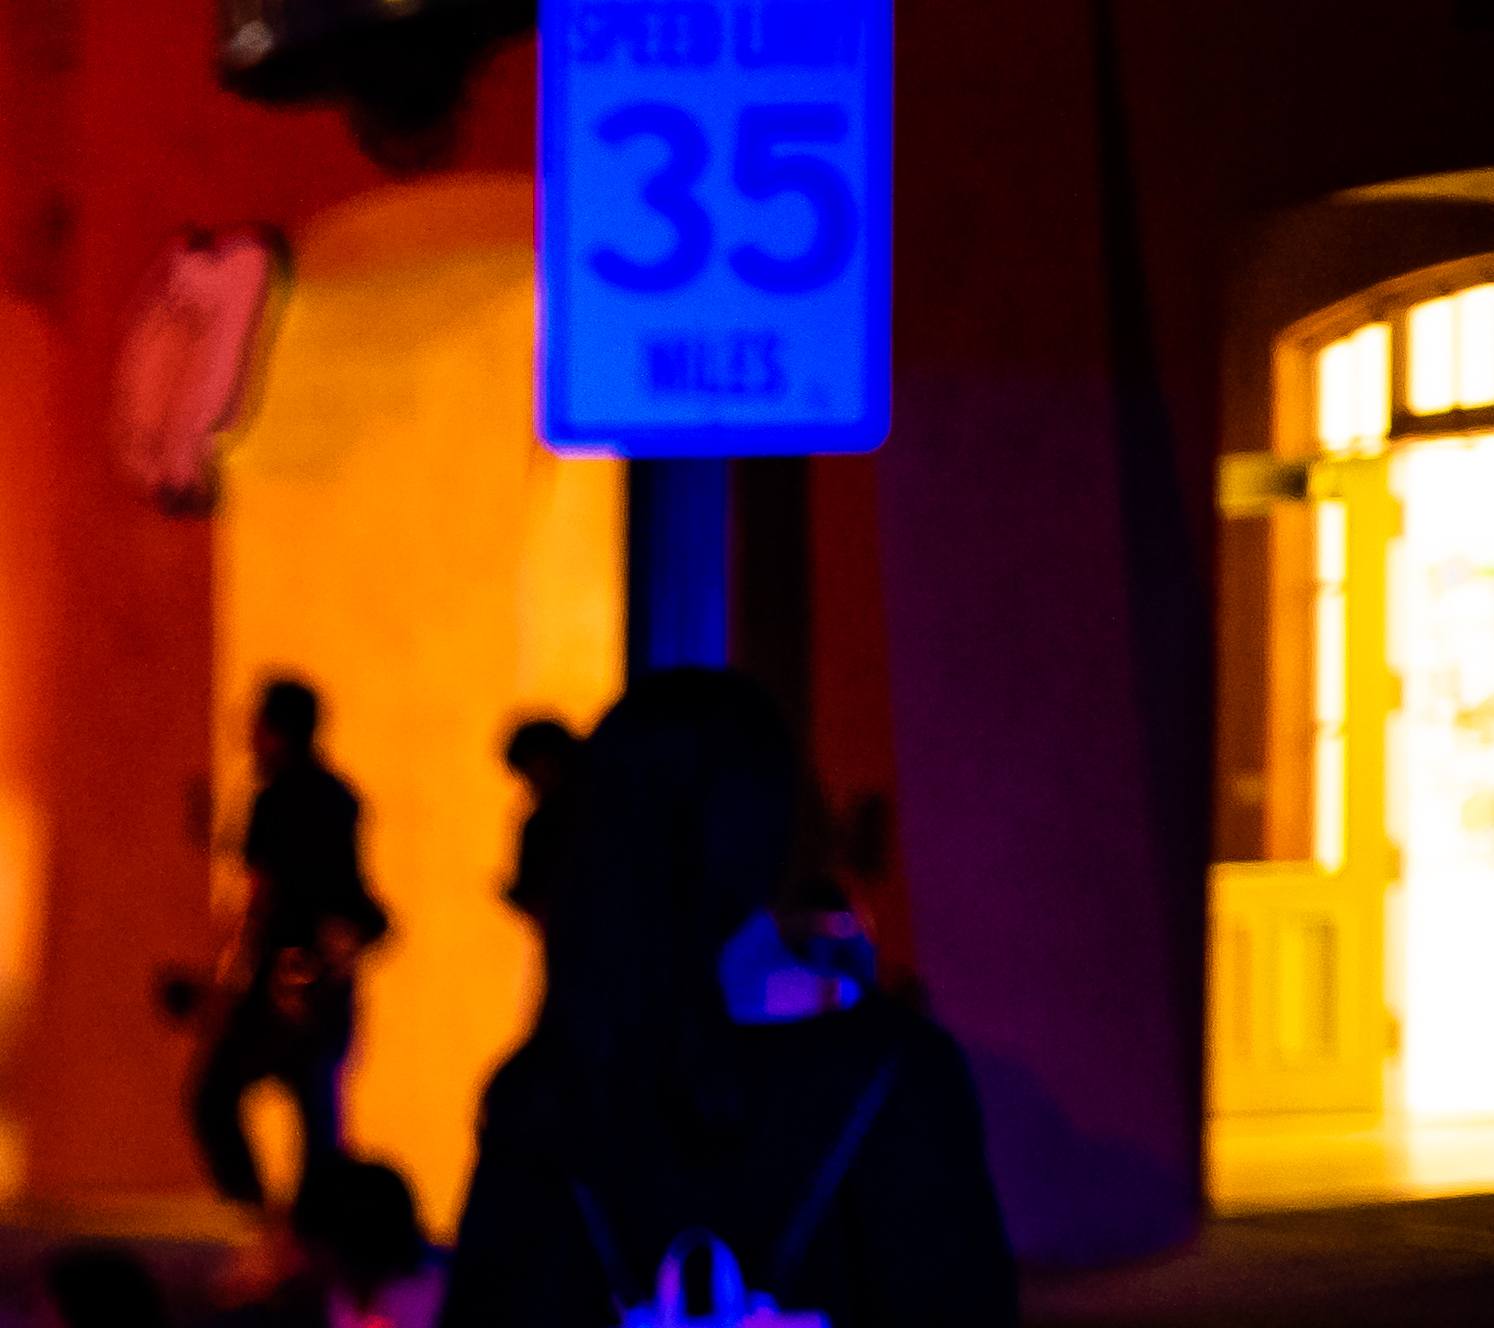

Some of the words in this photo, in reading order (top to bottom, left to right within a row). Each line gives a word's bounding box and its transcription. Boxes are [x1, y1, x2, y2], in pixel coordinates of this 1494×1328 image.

[563, 0, 720, 65] SPEED
[589, 103, 858, 293] 35
[647, 332, 787, 396] MILES
